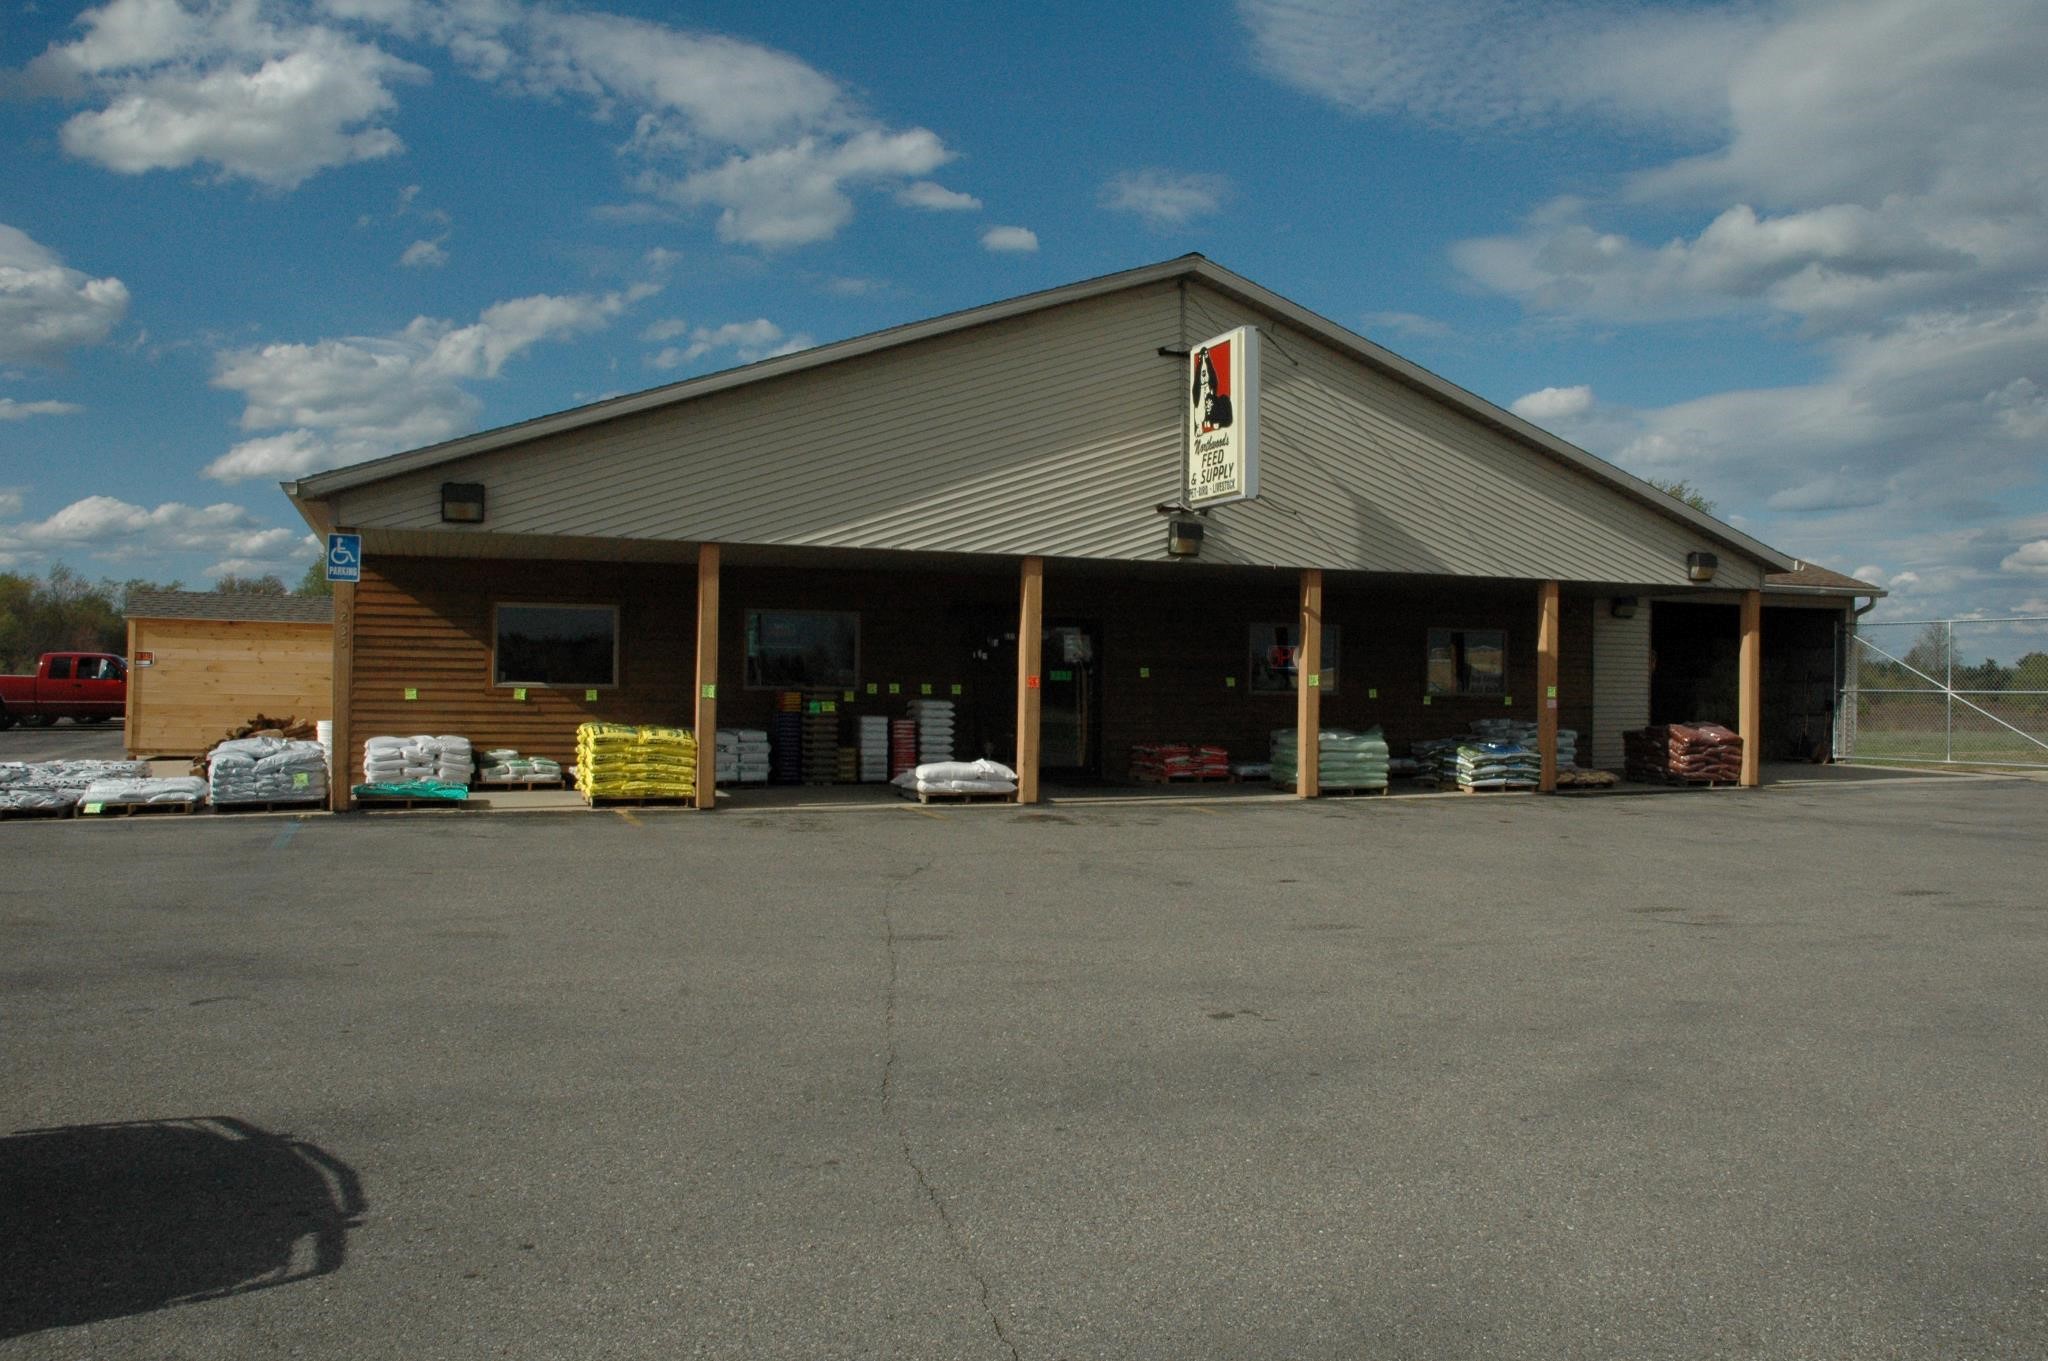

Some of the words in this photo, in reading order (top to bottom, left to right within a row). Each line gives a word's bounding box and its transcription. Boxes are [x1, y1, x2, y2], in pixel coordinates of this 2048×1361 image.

[1202, 449, 1224, 468] FEED
[1191, 473, 1197, 485] &
[1200, 463, 1234, 484] SUPPLY
[329, 566, 358, 577] PARKING
